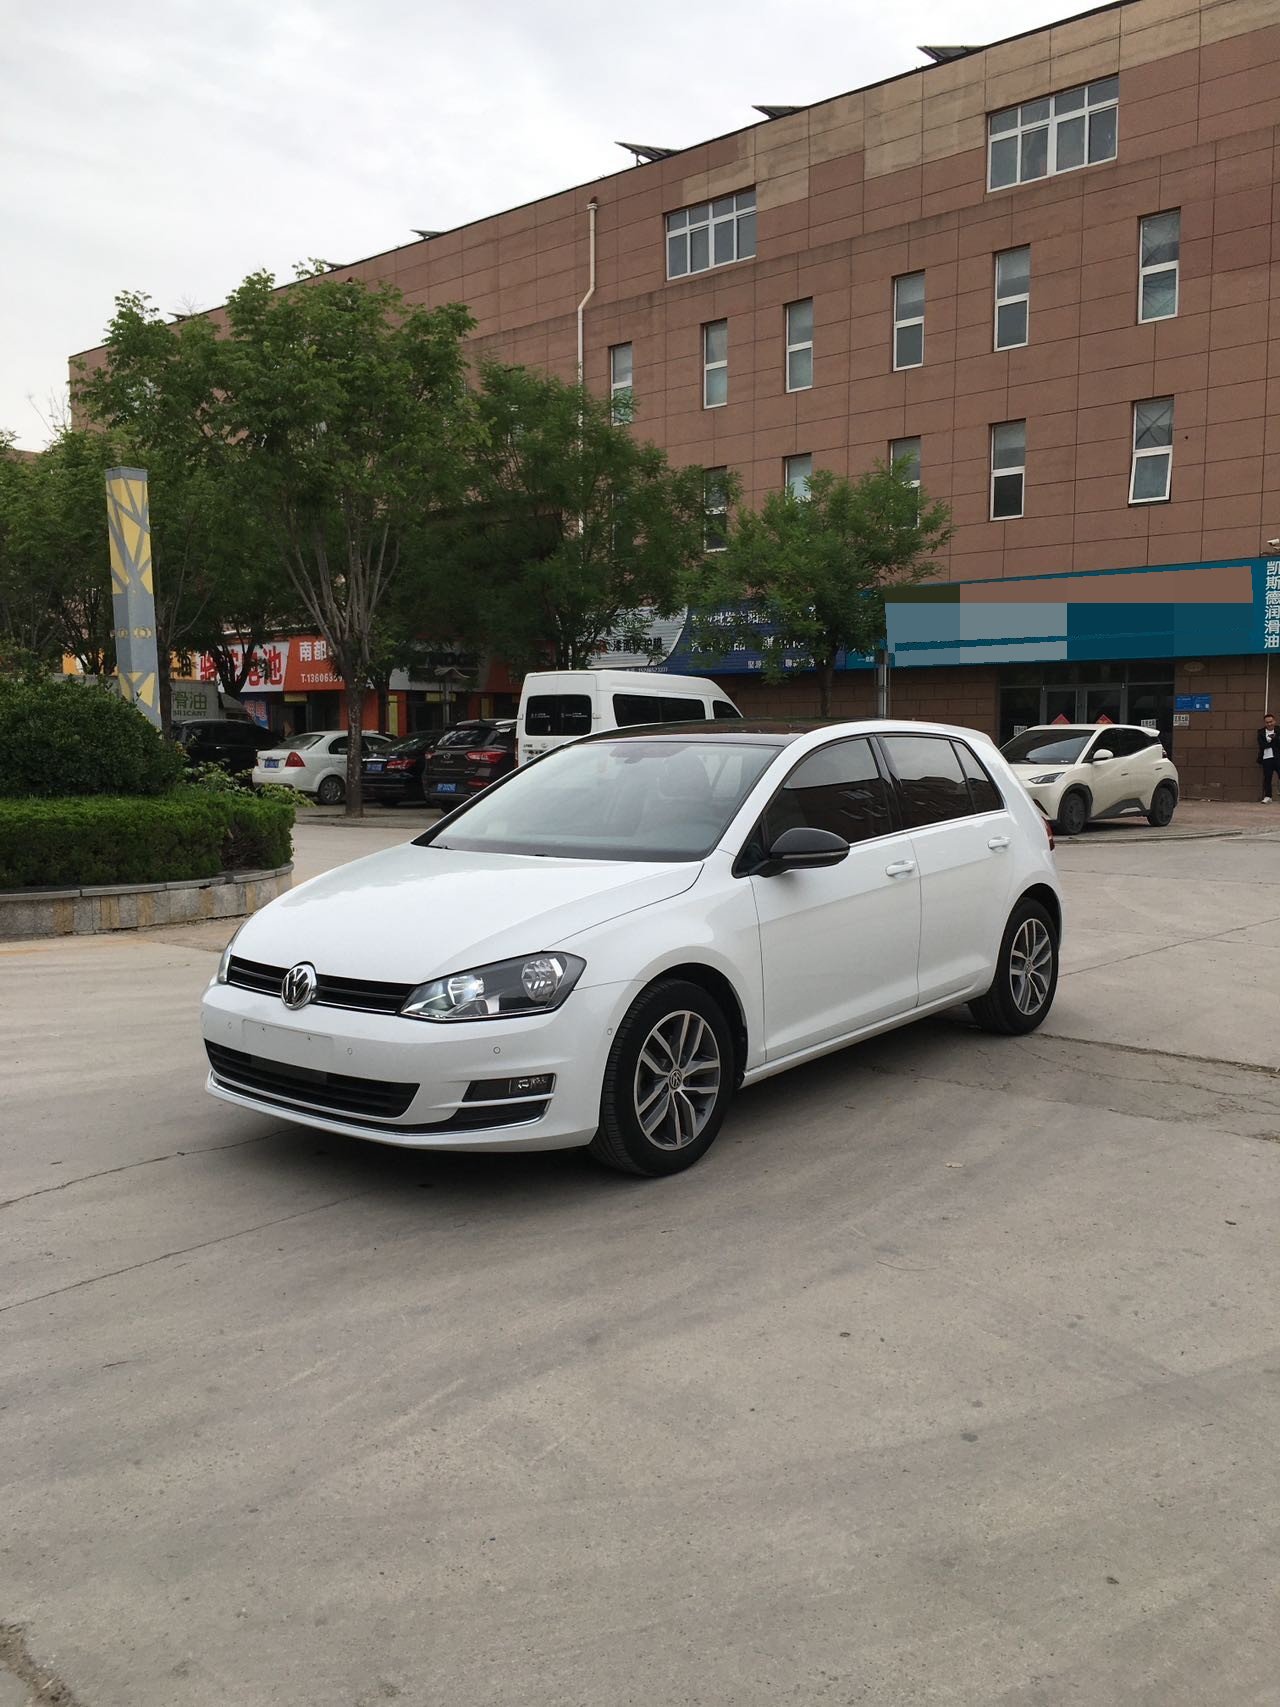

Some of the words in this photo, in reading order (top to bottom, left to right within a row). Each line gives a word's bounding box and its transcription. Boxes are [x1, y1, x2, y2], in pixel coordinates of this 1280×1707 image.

[1264, 560, 1280, 649] 凯斯德润滑油
[299, 640, 333, 661] 南都
